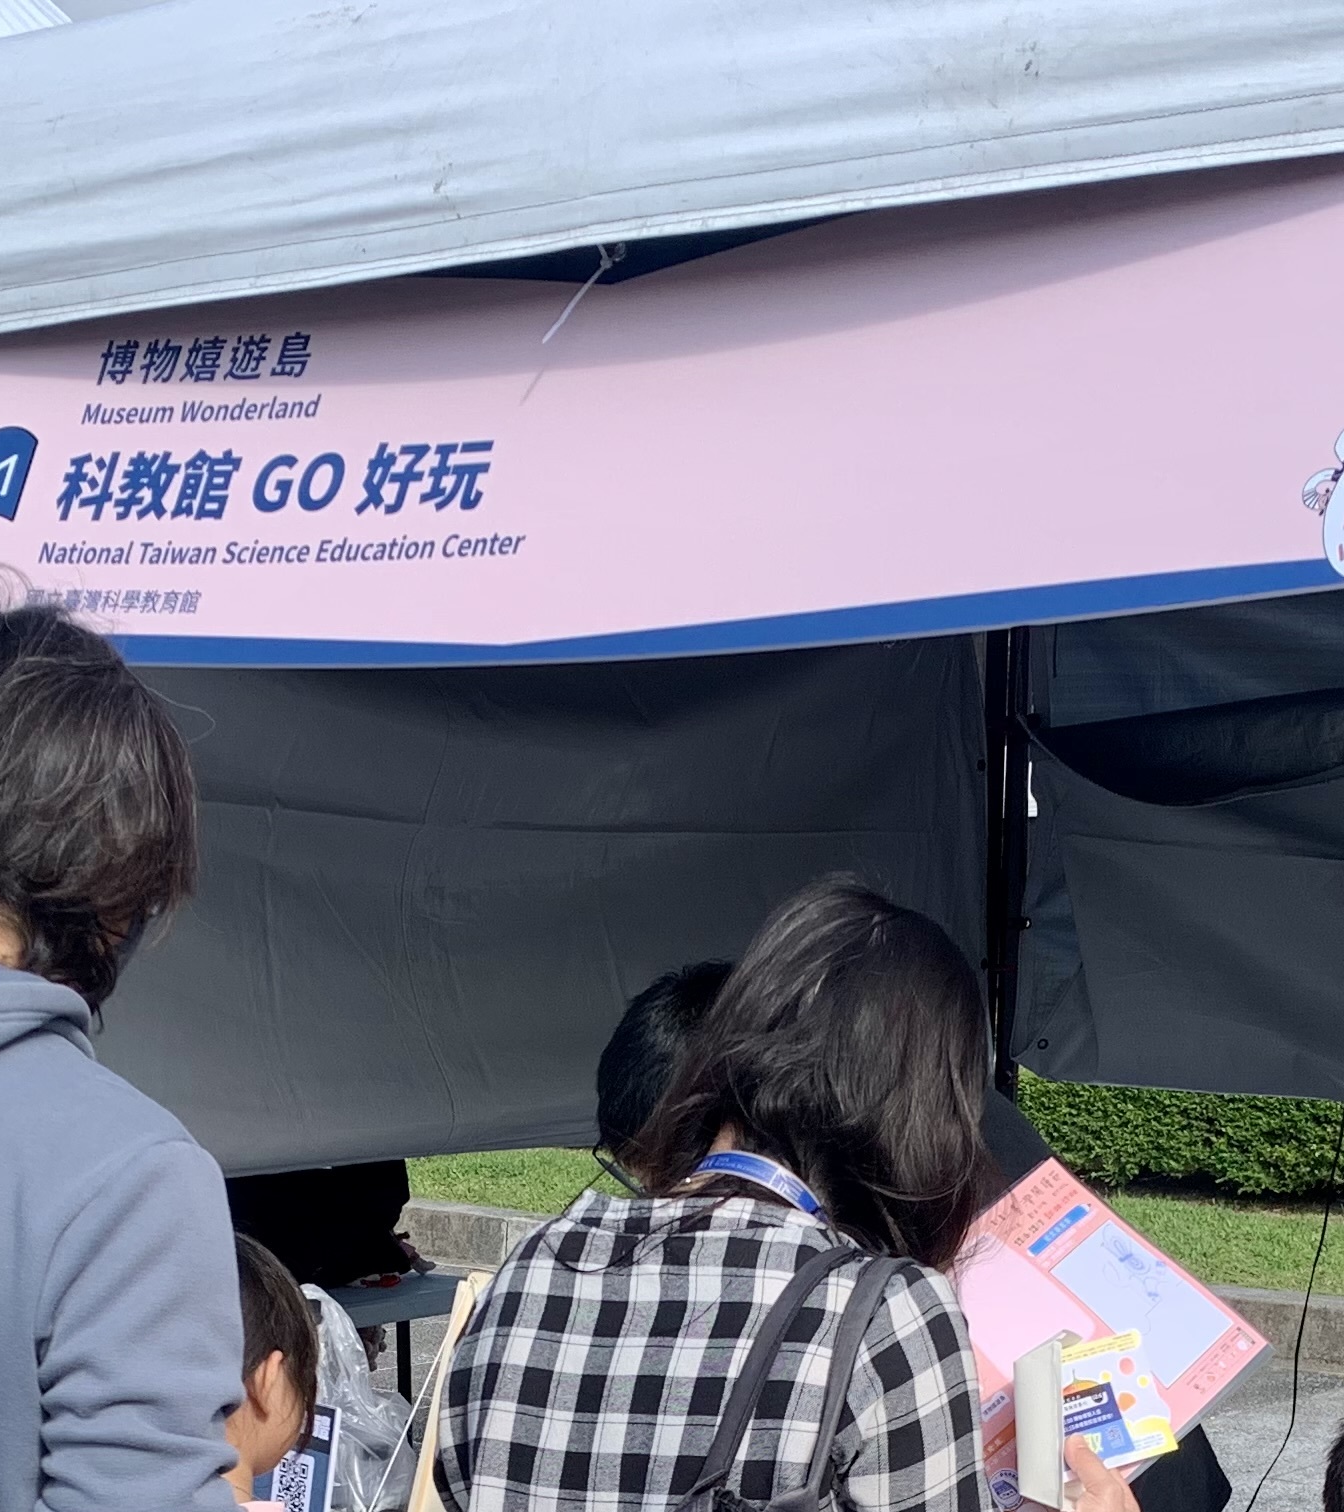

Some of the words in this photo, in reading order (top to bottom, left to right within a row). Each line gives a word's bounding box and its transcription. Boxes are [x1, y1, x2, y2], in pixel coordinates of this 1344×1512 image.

[96, 331, 312, 385] 博物嬉遊島
[81, 401, 174, 425] Museum
[180, 394, 321, 423] Wonderland
[56, 448, 242, 522] 科教館
[251, 452, 346, 514] GO
[355, 440, 494, 516] 好玩
[38, 540, 133, 566] National
[140, 541, 218, 566] Taiwan
[222, 538, 310, 565] Science
[316, 535, 436, 563] Education
[442, 530, 525, 559] Center
